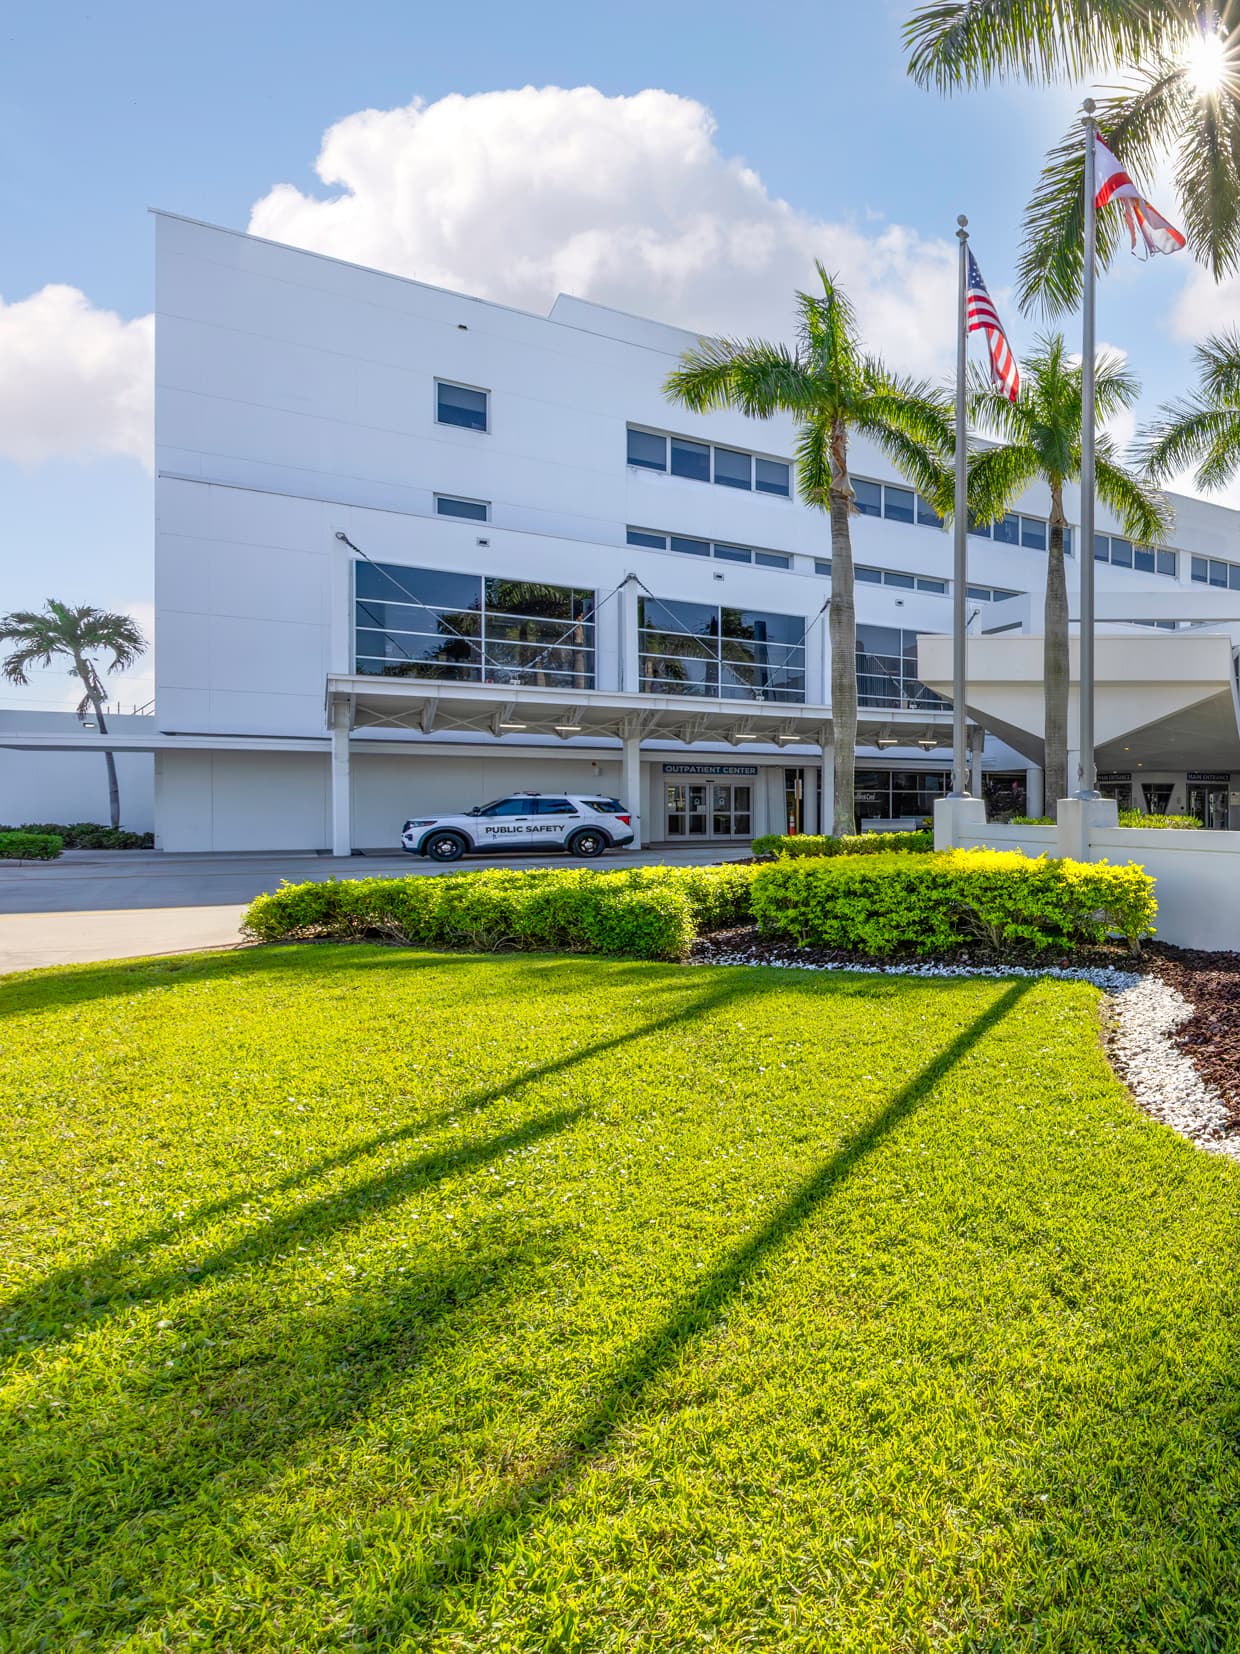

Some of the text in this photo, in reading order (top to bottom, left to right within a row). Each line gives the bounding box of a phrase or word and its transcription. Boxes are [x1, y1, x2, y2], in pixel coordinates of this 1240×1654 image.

[665, 765, 756, 775] OUTPATIENT CENTER
[485, 824, 565, 834] PUBLIC SAFETY
